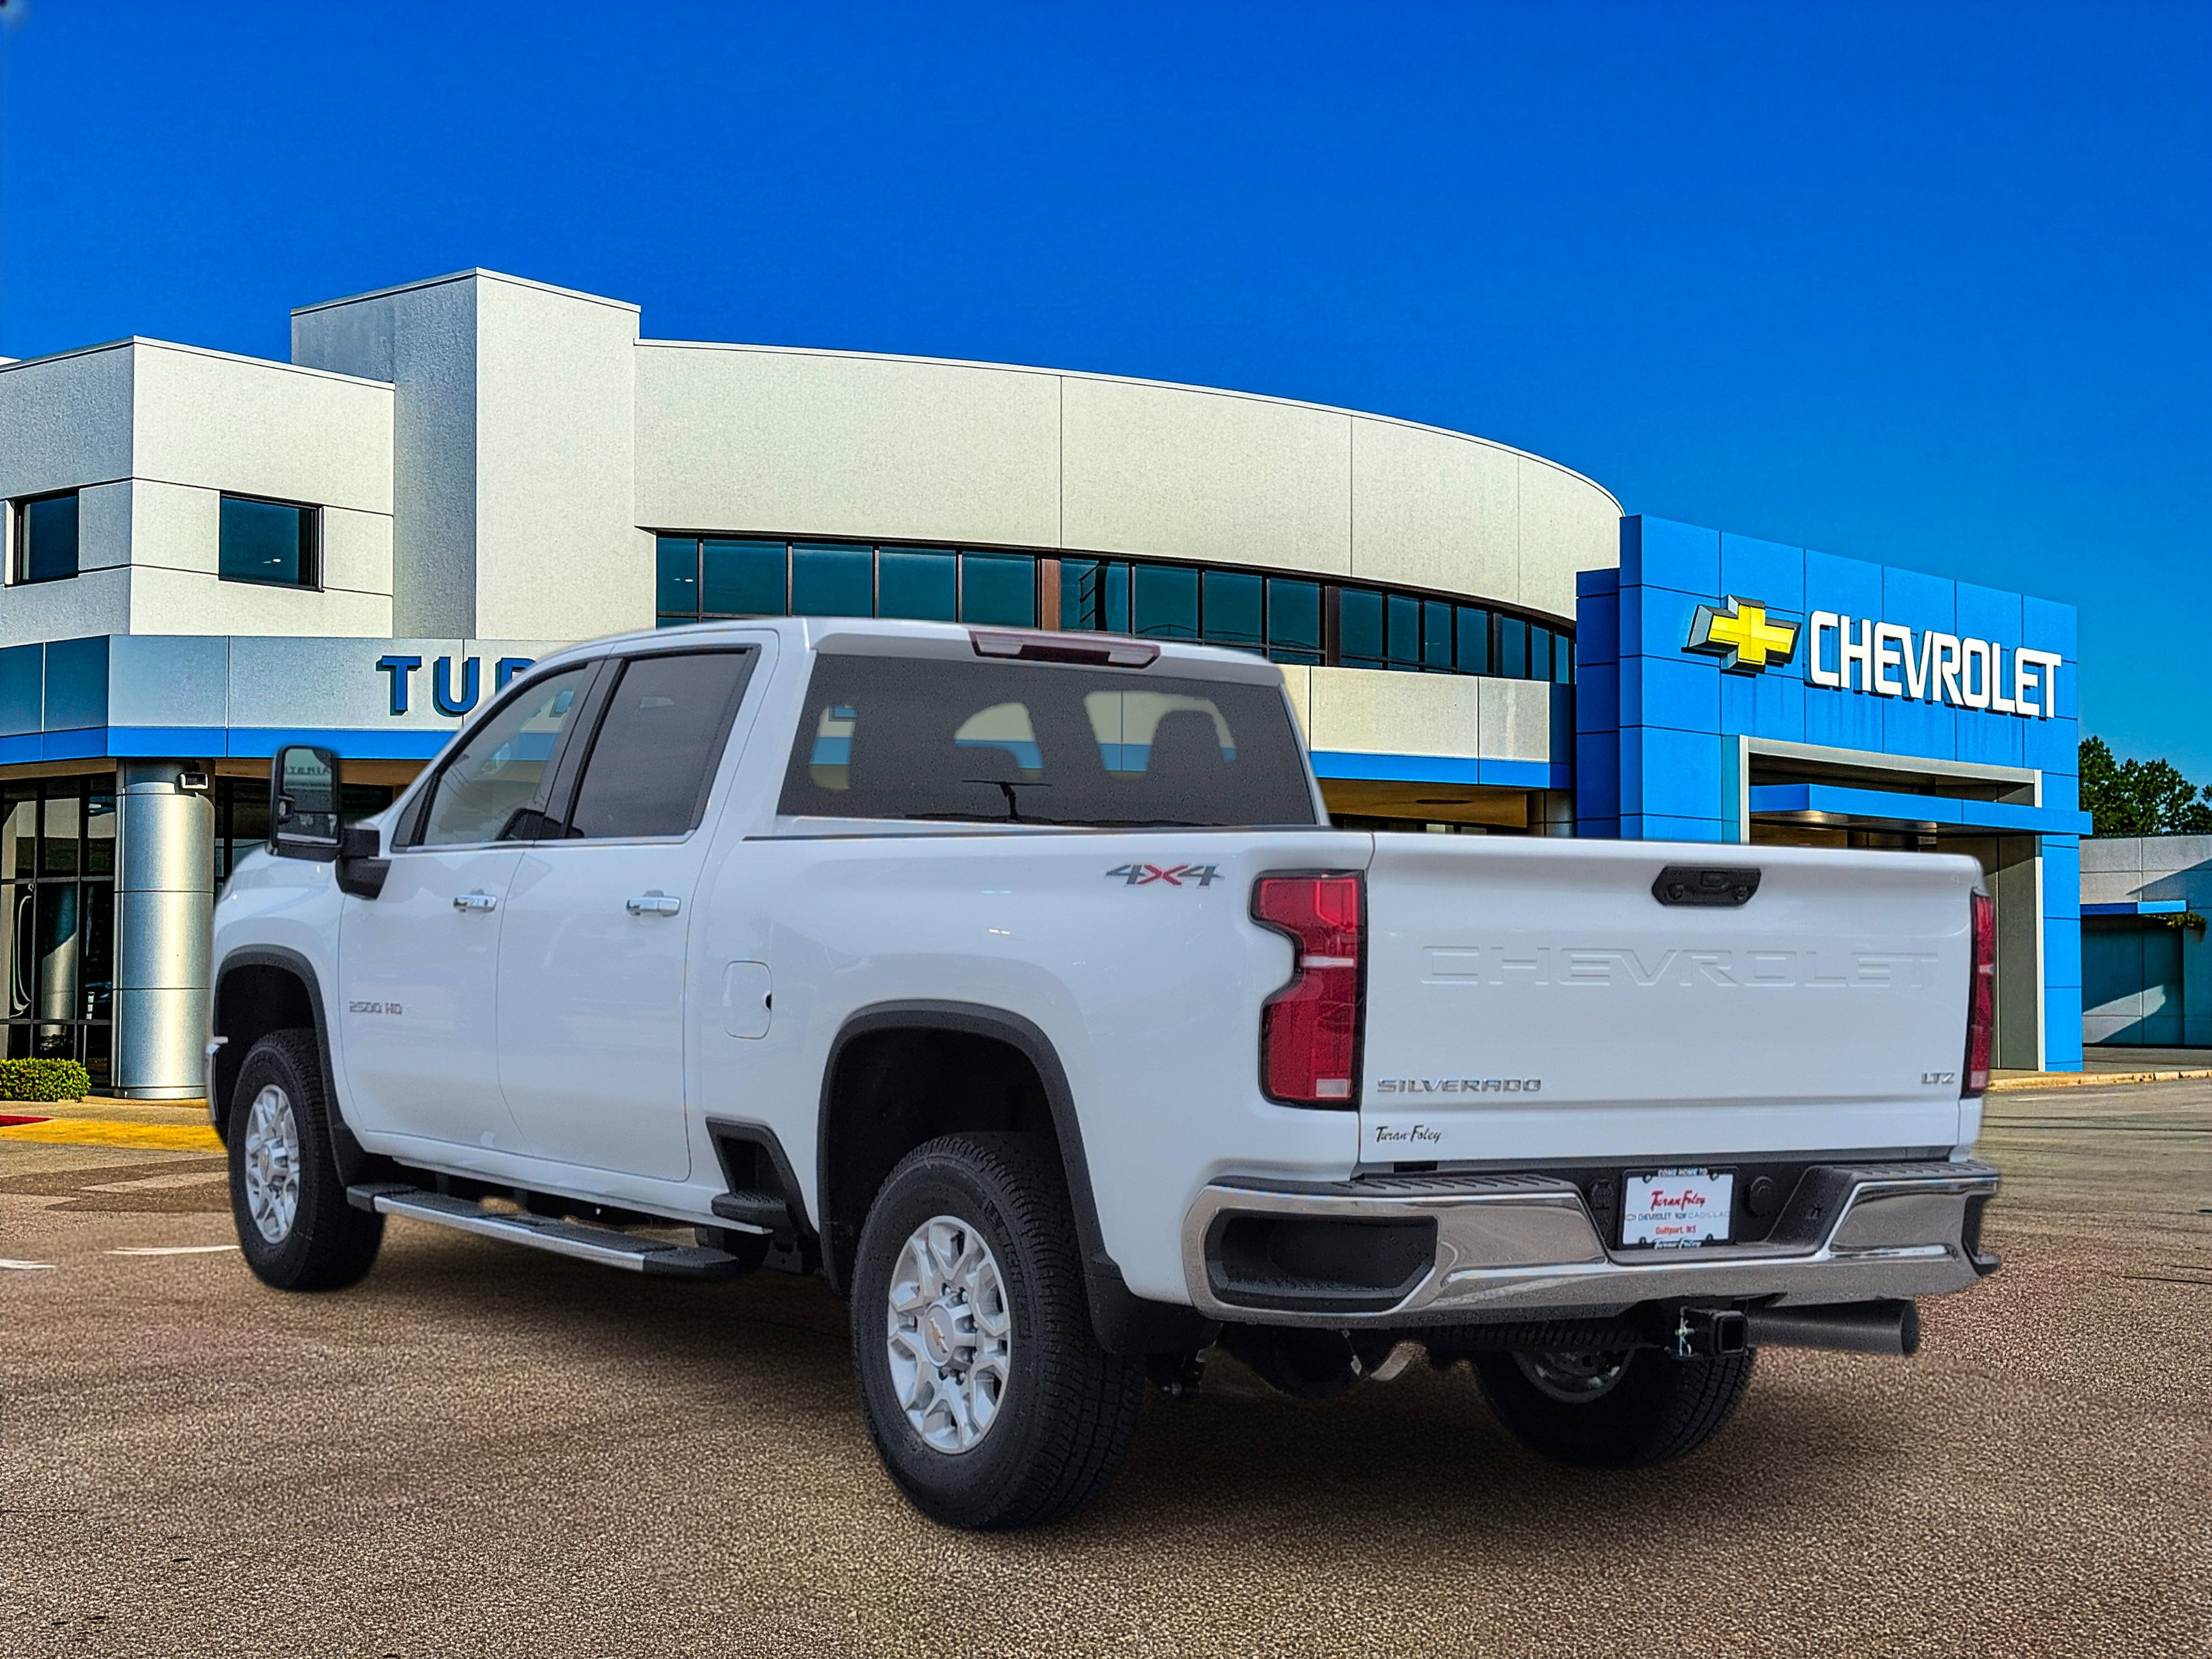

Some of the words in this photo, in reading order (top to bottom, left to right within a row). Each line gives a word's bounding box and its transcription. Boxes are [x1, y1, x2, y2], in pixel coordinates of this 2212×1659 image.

[1810, 609, 2062, 718] CHEVROLET
[1421, 945, 1939, 988] CHEVROLET
[349, 1001, 382, 1014] 2500
[385, 1002, 402, 1015] HD
[1377, 1078, 1542, 1093] SILVERADO
[1921, 1072, 1954, 1085] LTZ
